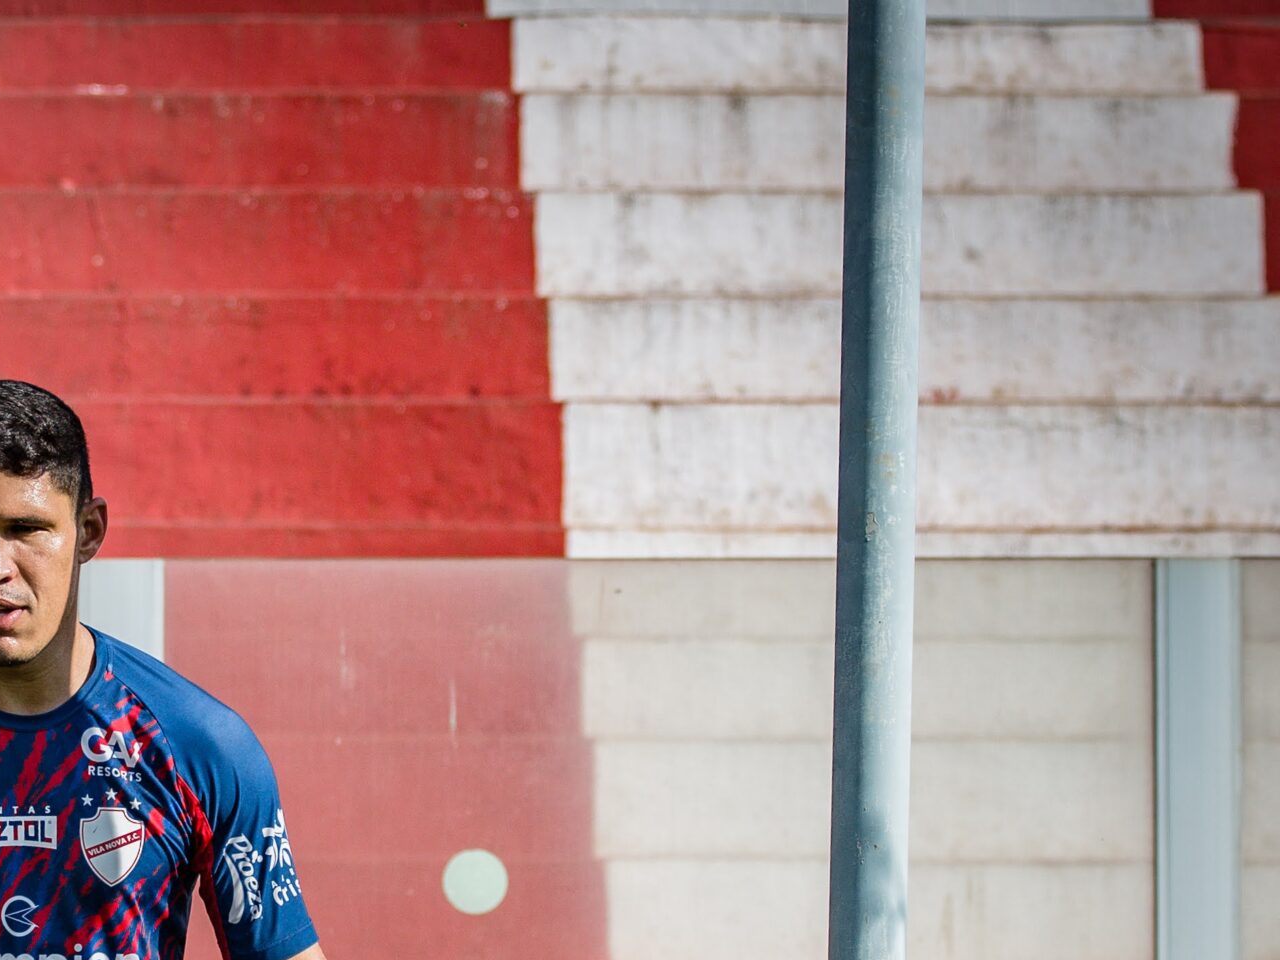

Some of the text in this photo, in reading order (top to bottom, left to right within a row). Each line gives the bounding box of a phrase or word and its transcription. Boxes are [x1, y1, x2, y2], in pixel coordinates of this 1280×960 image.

[87, 765, 142, 782] RESORTS
[87, 832, 140, 857] VILA NOVA F.C.
[226, 833, 263, 921] Proeza
